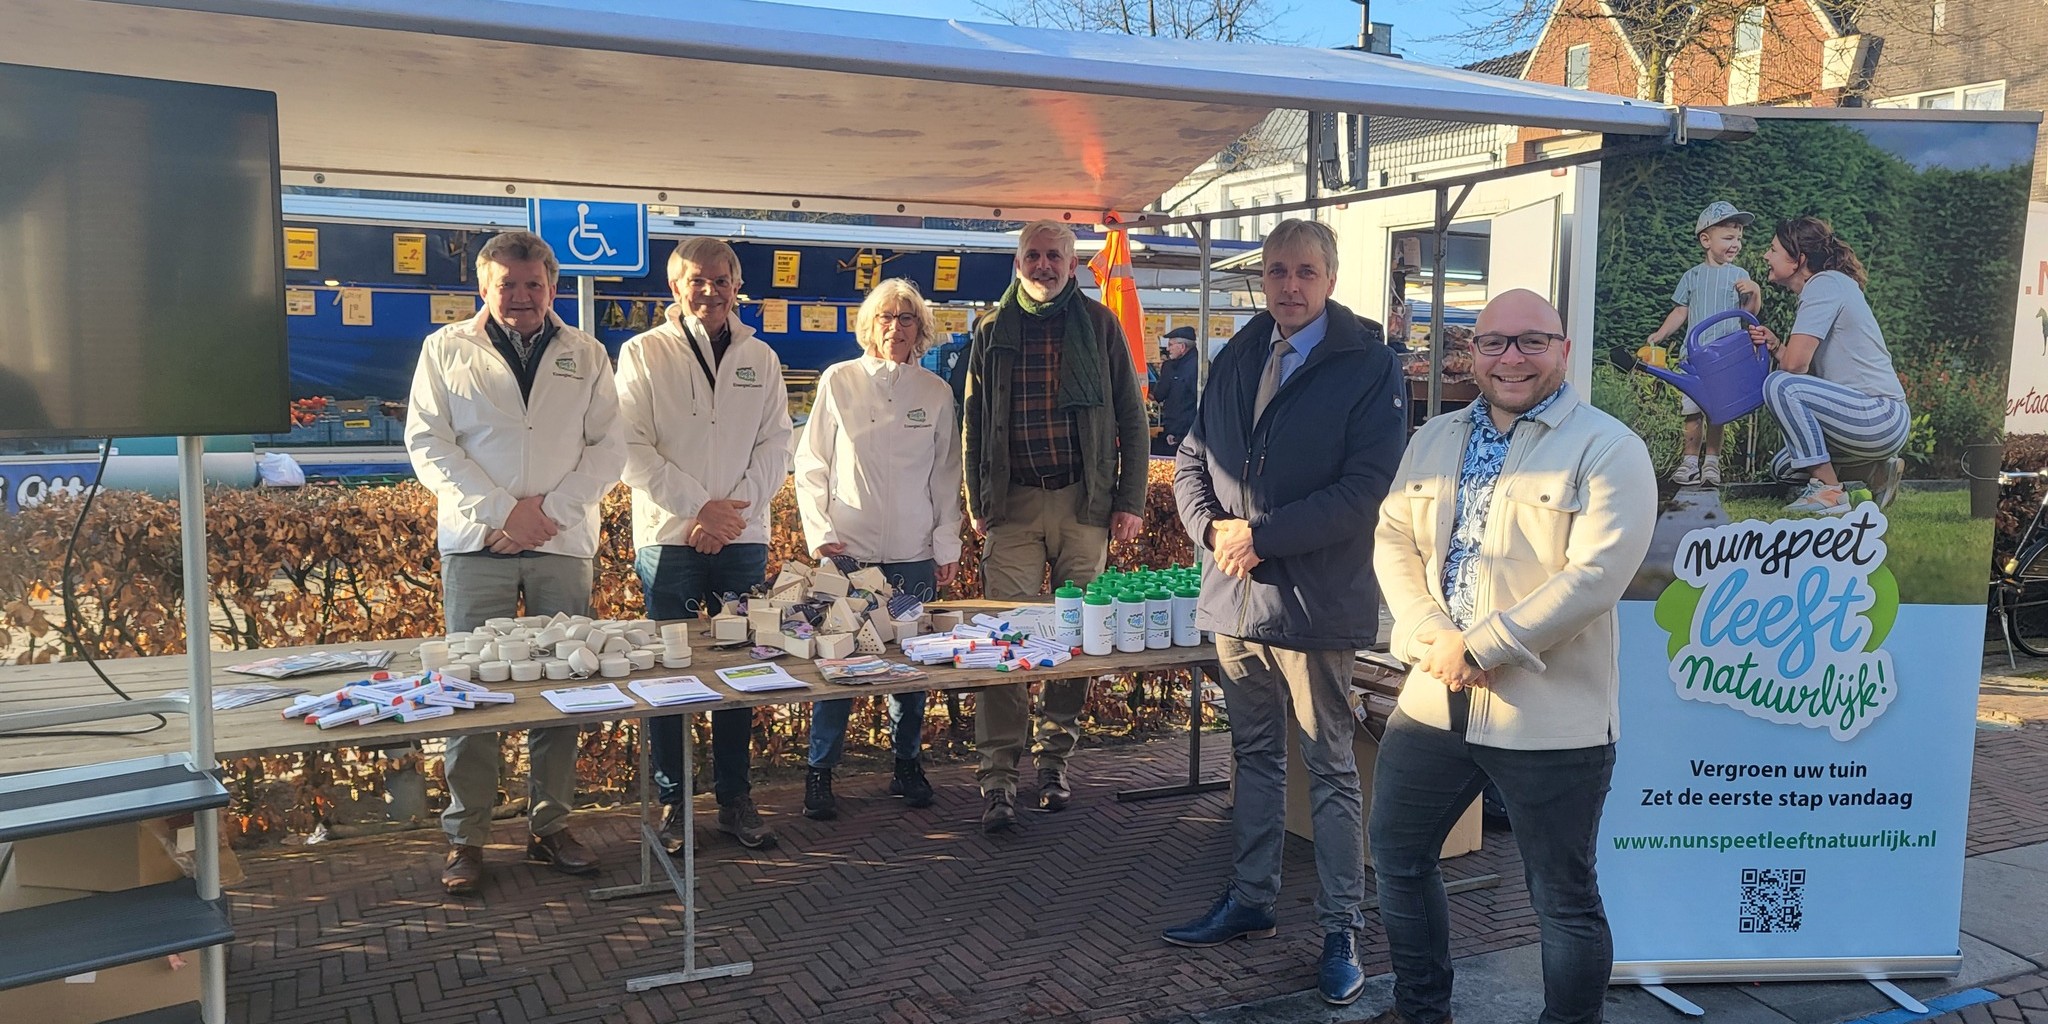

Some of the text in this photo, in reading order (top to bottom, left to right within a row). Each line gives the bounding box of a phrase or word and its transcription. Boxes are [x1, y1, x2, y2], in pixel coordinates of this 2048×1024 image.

[1684, 512, 1877, 578] nunspeet
[1700, 566, 1866, 679] leeft
[1679, 652, 1887, 730] natuurlijk!
[1690, 760, 1867, 781] Vergroen uw tuin
[1641, 788, 1913, 811] Zet de eerste stap vandaag
[1613, 829, 1937, 853] www.nunspeetleeftnatuurlijk.nl
